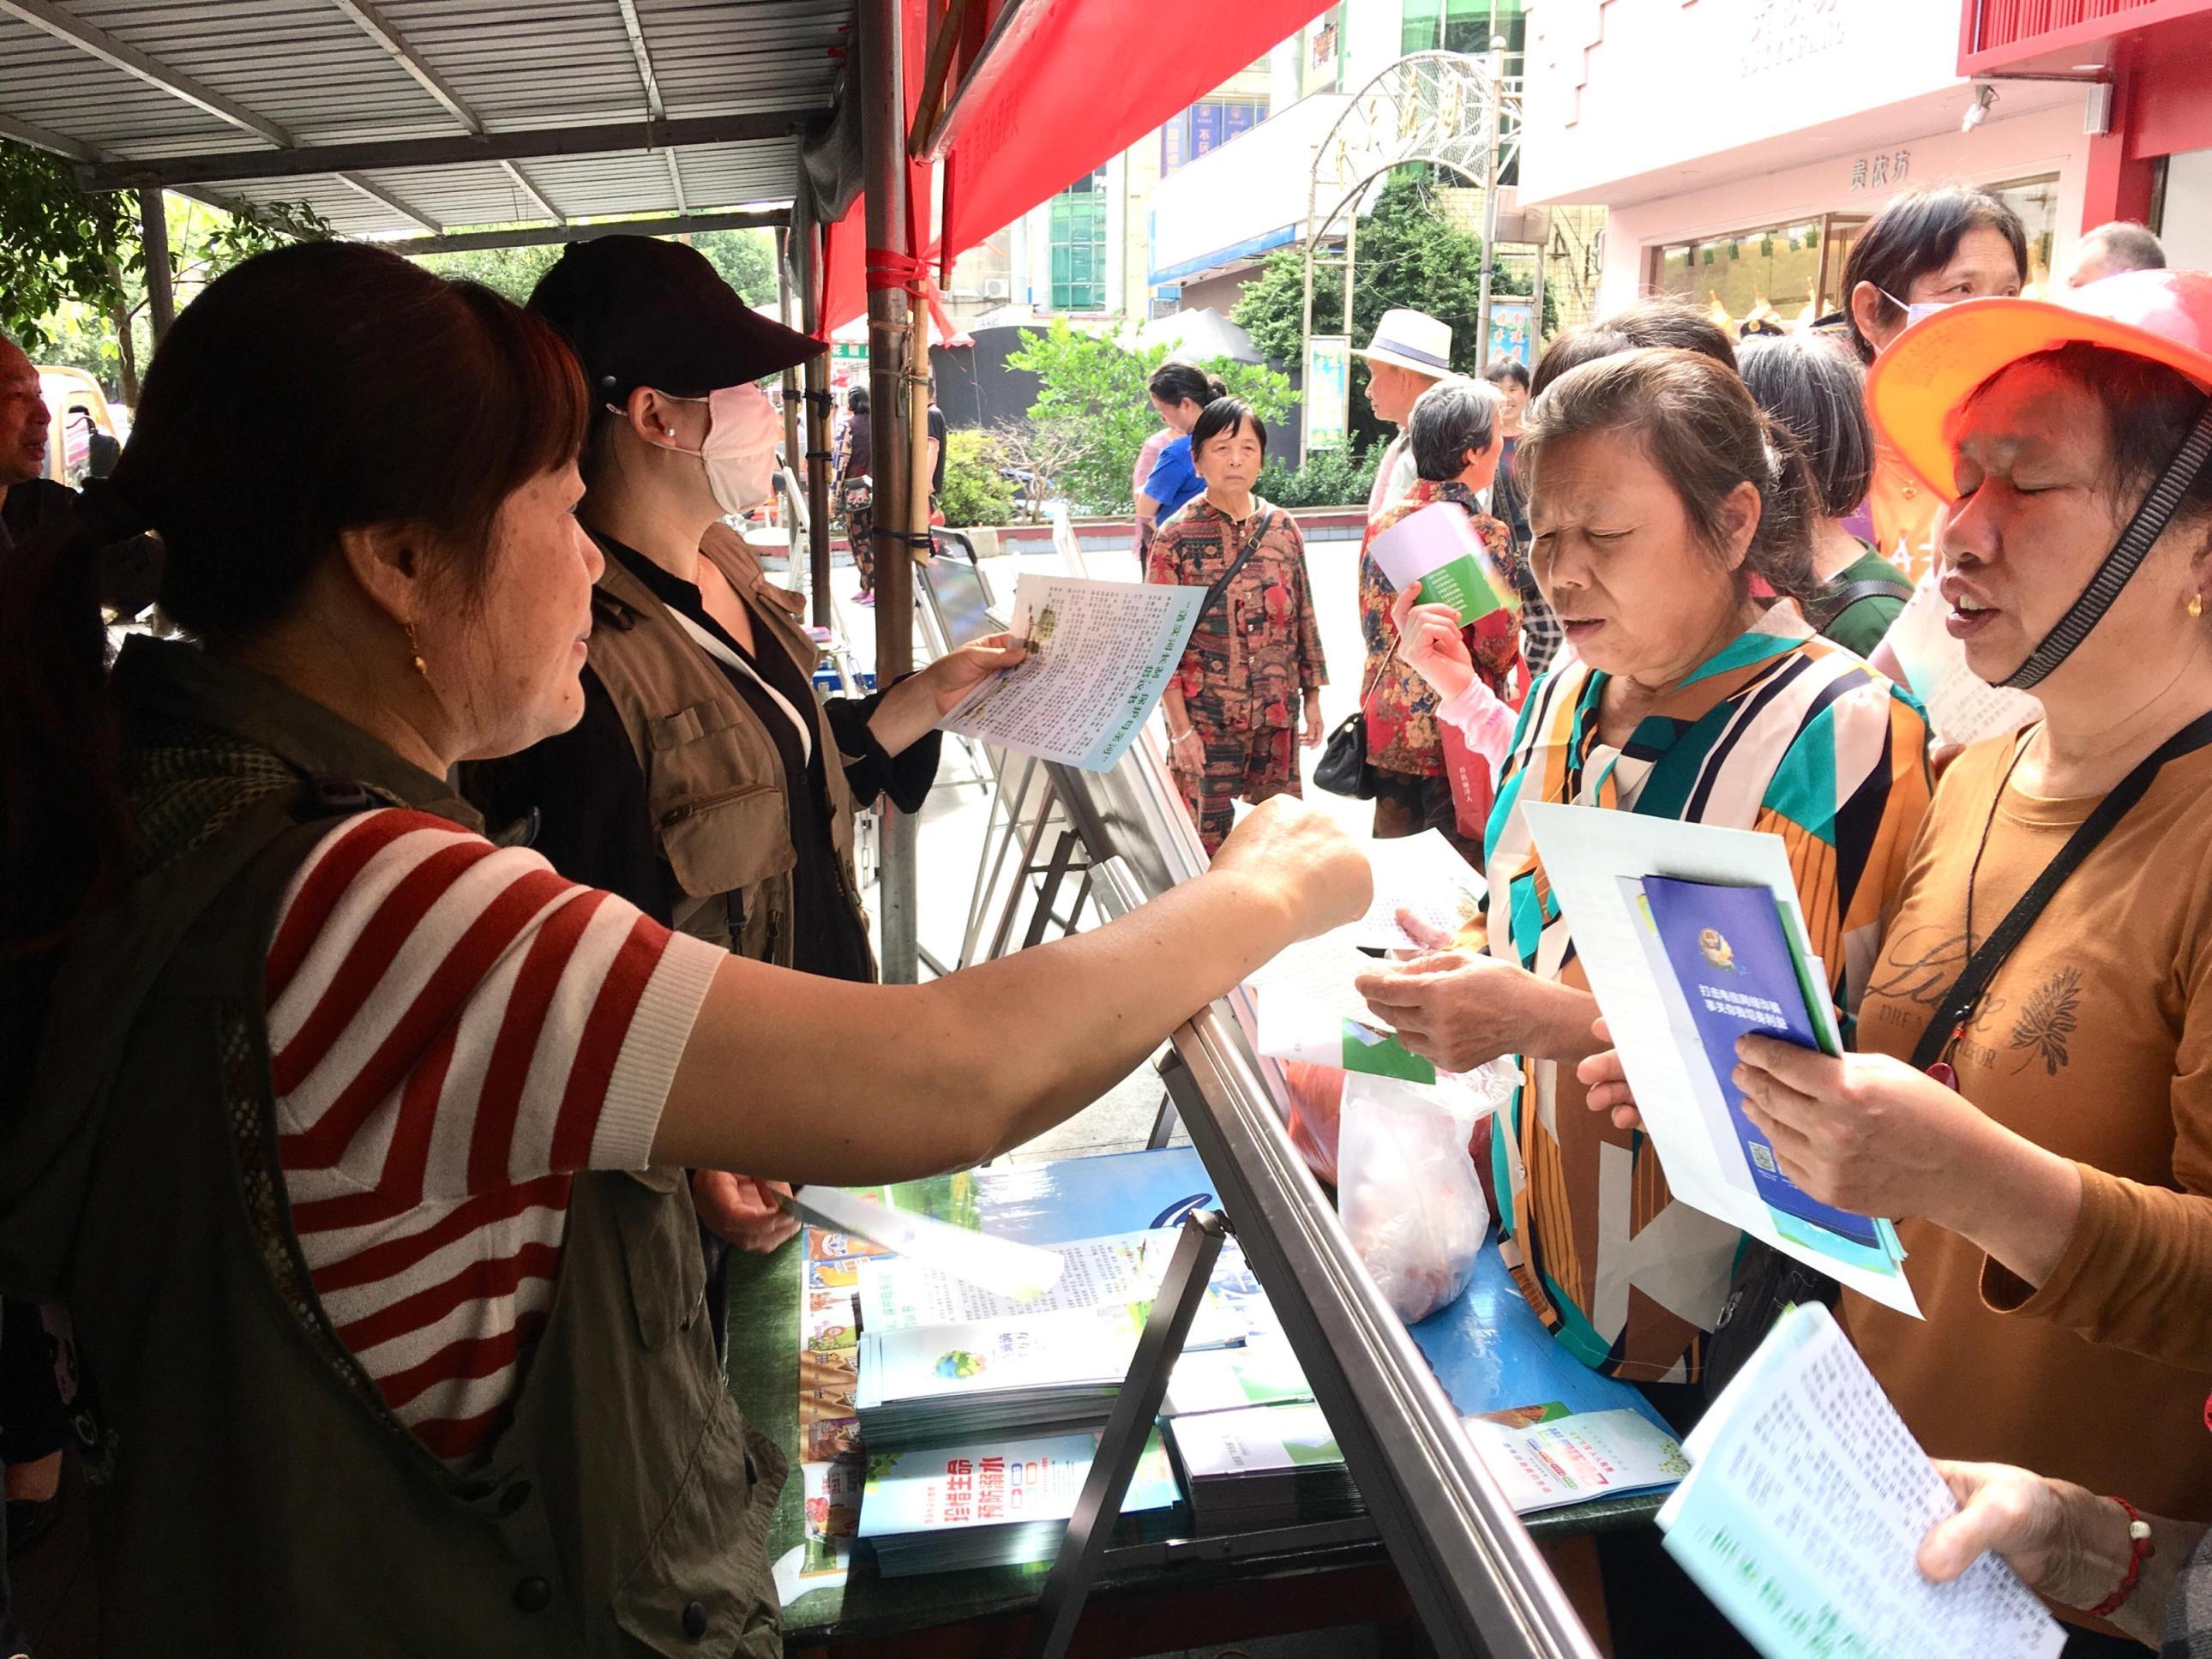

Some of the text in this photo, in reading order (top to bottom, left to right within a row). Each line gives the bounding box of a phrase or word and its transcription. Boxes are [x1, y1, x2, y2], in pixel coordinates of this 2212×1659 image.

[944, 1458, 973, 1522] 珍惜生命
[977, 1456, 1005, 1518] 预防溺水
